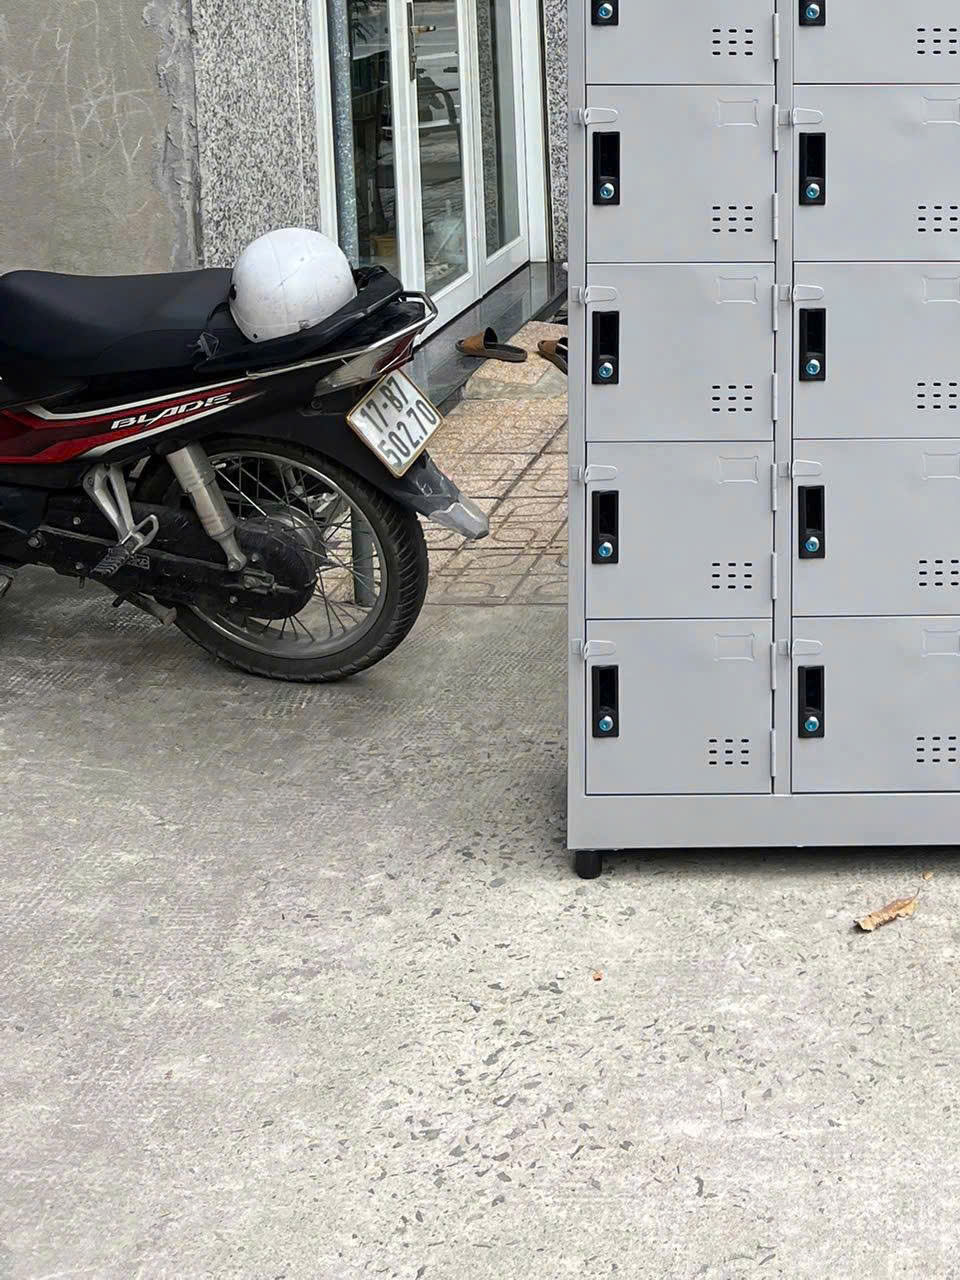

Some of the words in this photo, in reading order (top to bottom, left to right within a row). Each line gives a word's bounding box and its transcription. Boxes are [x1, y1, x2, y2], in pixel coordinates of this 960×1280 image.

[111, 392, 232, 430] BLADE
[361, 376, 408, 432] 17-B7
[378, 400, 437, 467] 502.70
